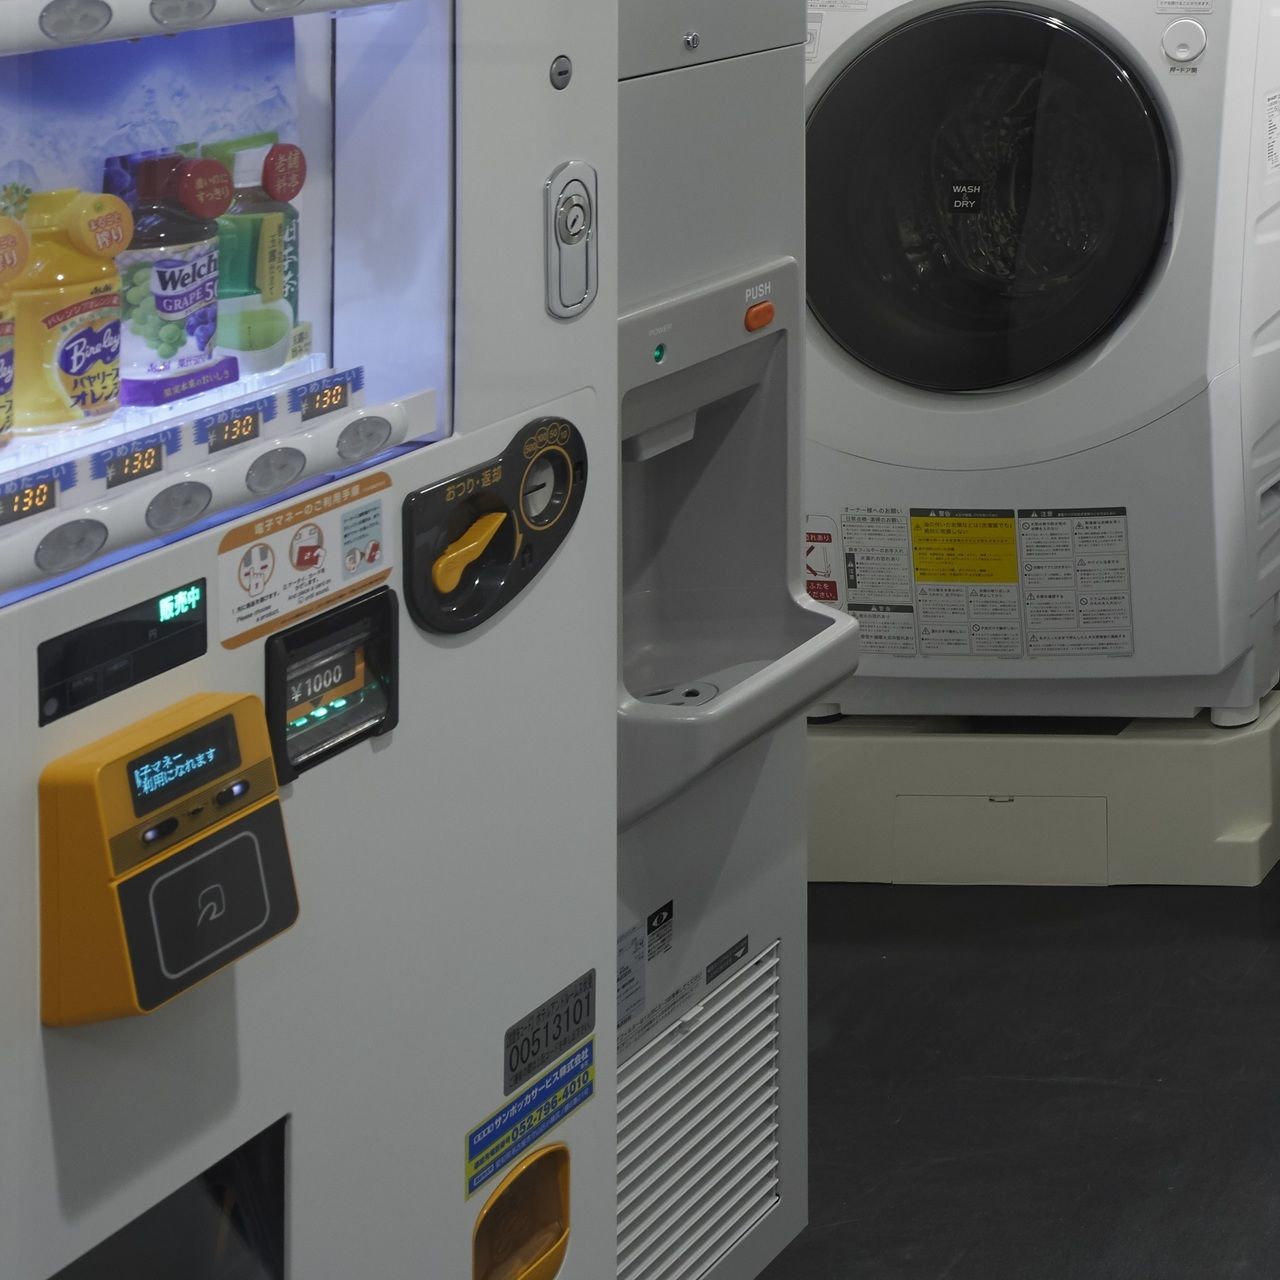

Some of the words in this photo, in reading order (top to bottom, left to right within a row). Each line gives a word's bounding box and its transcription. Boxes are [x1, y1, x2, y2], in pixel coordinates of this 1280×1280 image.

[196, 188, 230, 203] すっきり
[952, 185, 981, 193] WASH
[954, 200, 976, 208] DRY
[156, 251, 218, 291] Welch
[162, 291, 203, 312] GRAPE
[745, 281, 771, 302] PUSH
[649, 323, 673, 337] POWER
[315, 385, 342, 409] 130
[223, 416, 253, 440] 130
[123, 448, 156, 474] 130
[445, 465, 502, 502] おつり・返却
[13, 484, 48, 512] 130
[158, 585, 201, 623] 販売中
[509, 992, 591, 1073] 00513101
[510, 1071, 590, 1142] 052-796-4010
